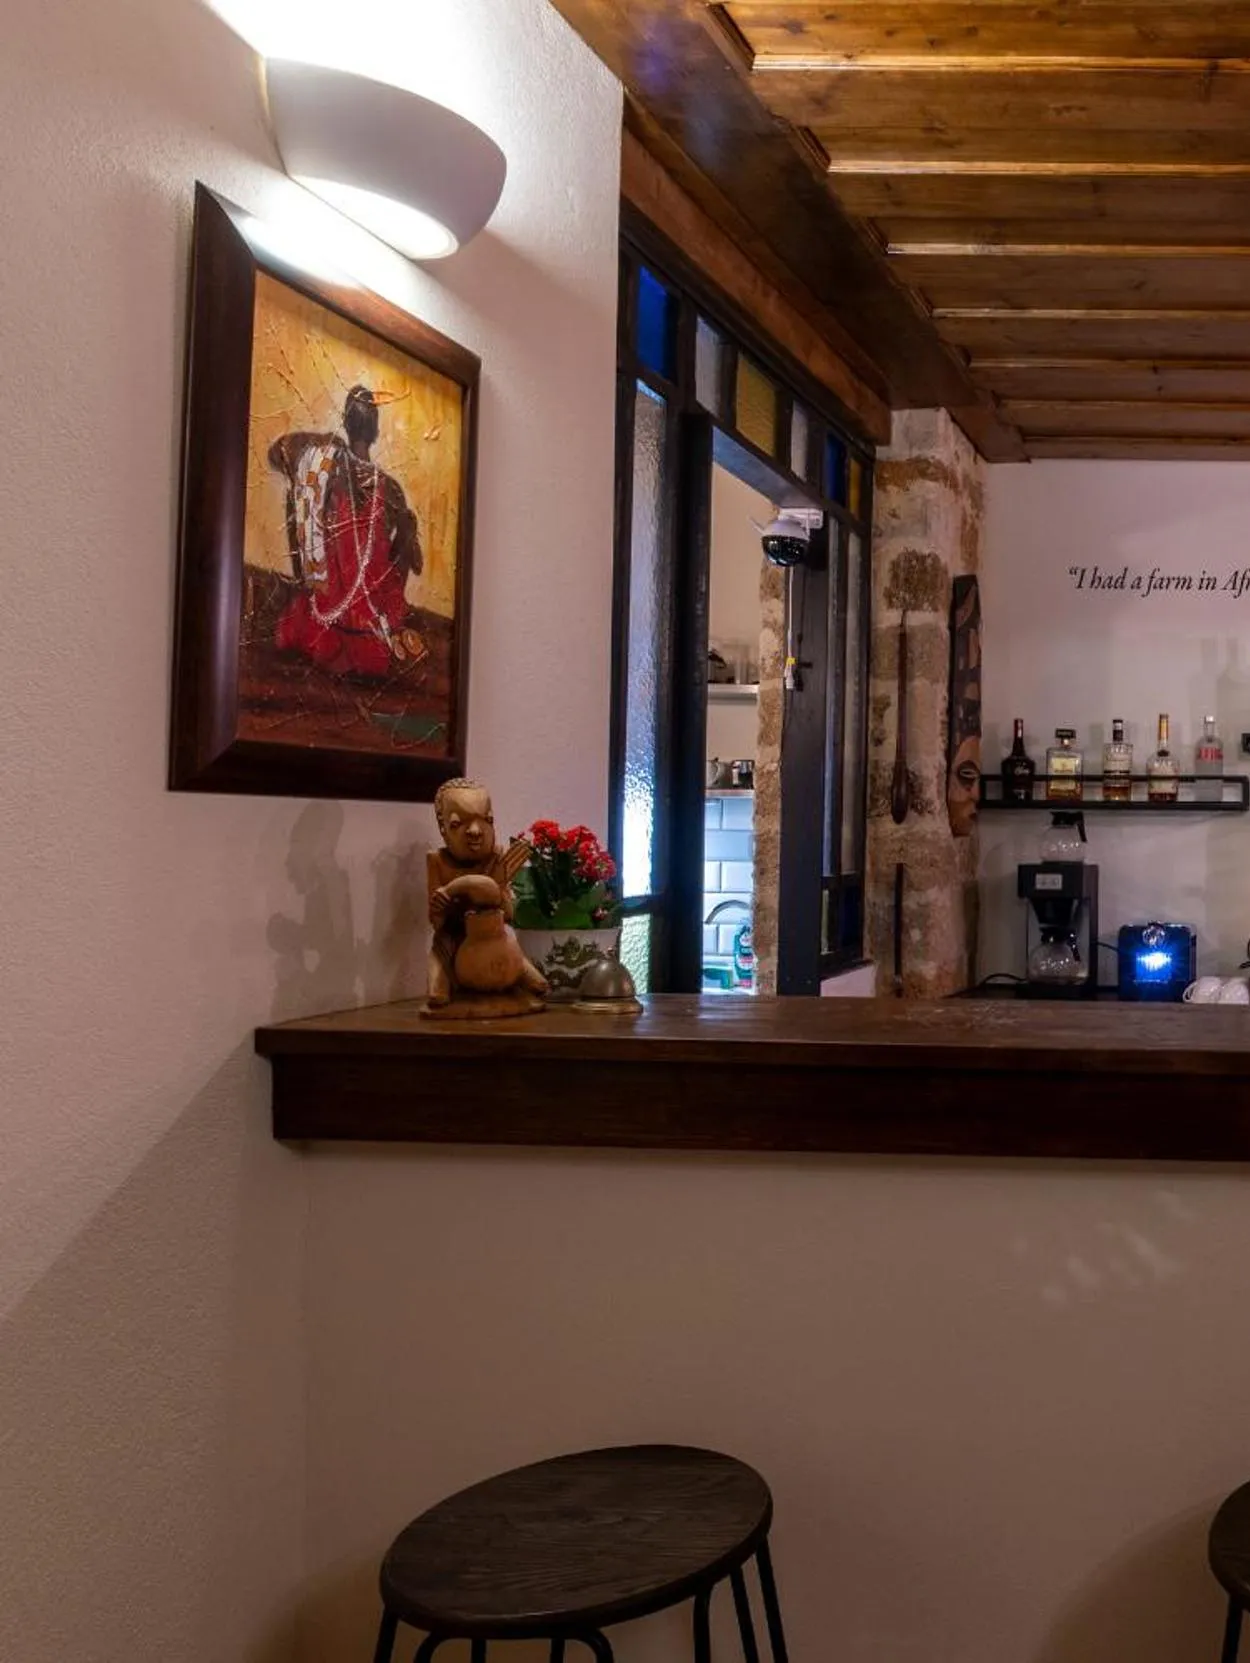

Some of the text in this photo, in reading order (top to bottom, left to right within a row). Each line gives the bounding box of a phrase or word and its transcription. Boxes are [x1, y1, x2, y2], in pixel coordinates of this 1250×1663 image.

[1069, 566, 1086, 589] “I
[1090, 565, 1128, 590] had
[1131, 575, 1142, 590] a
[1141, 567, 1193, 598] farm
[1198, 570, 1217, 591] in
